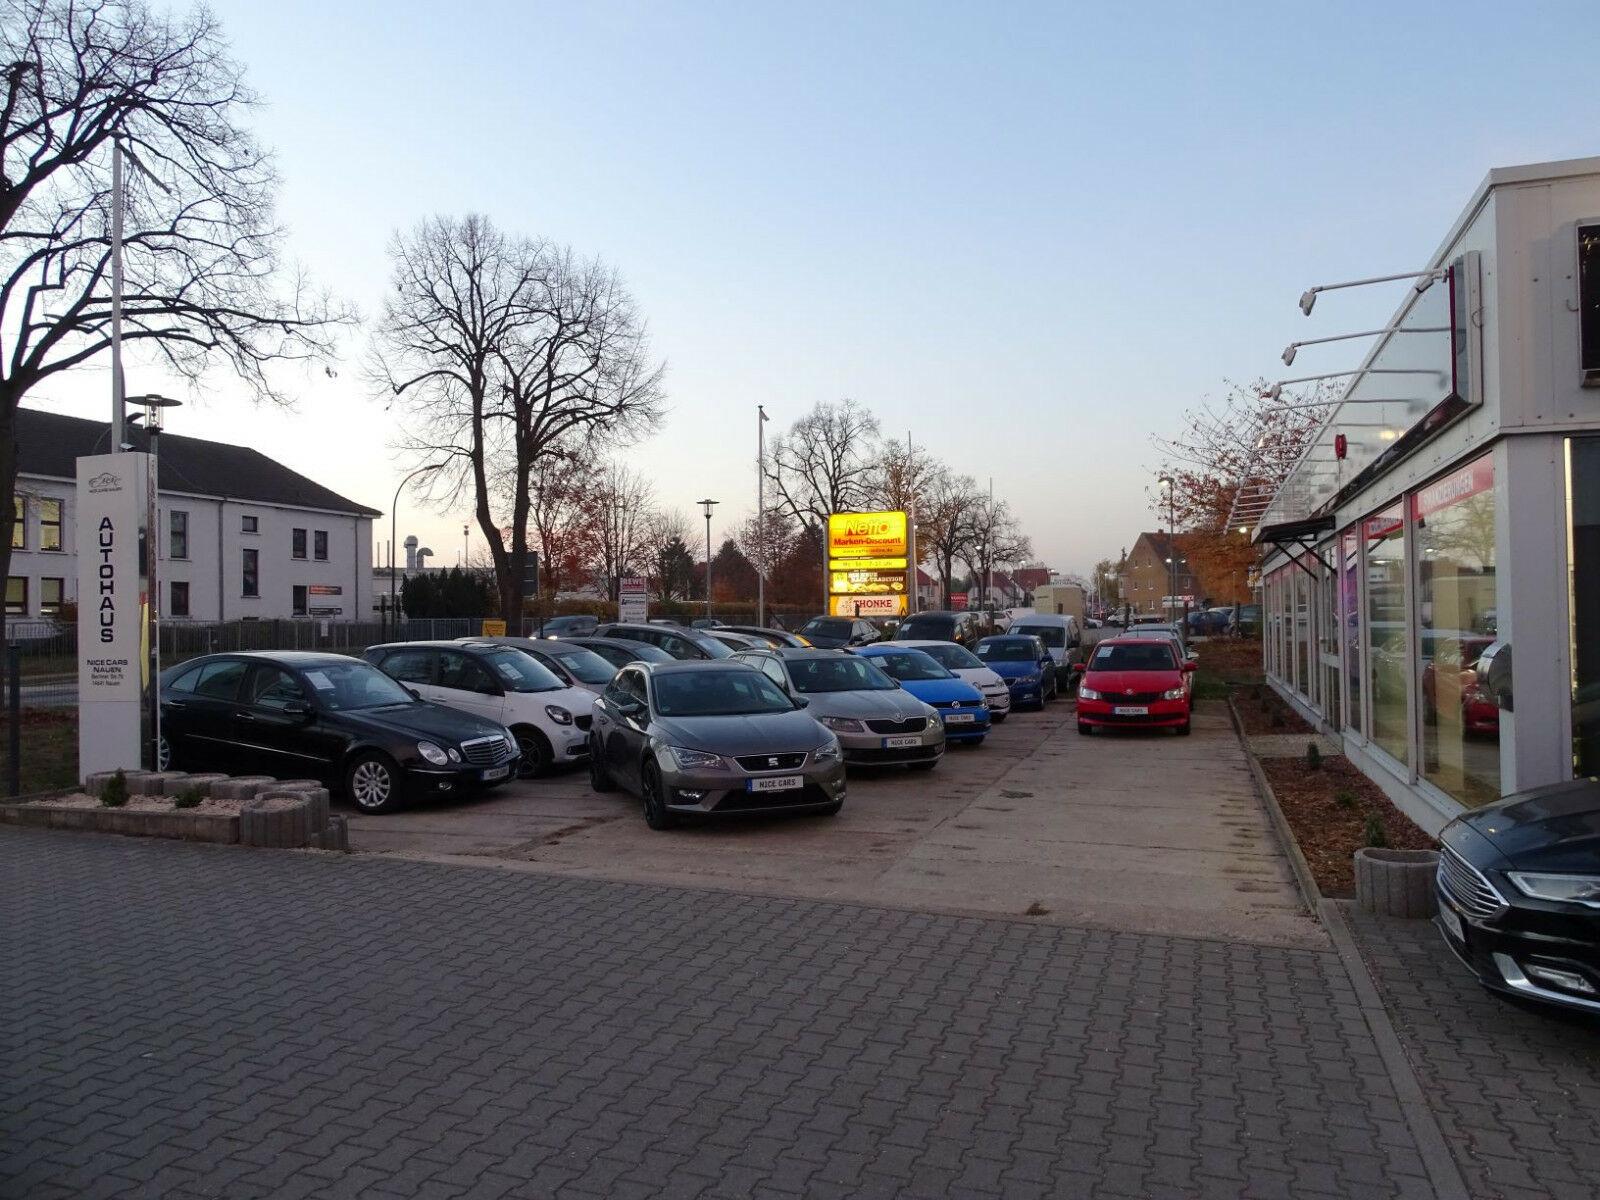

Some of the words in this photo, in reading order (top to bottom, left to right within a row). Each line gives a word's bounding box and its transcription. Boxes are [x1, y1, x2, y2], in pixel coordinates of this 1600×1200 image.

[845, 519, 889, 536] Netto
[833, 537, 901, 546] Marken-Discount
[99, 516, 114, 643] AUTOHAUS
[890, 738, 903, 746] NICE
[759, 780, 777, 788] NICE
[778, 778, 796, 787] CARS
